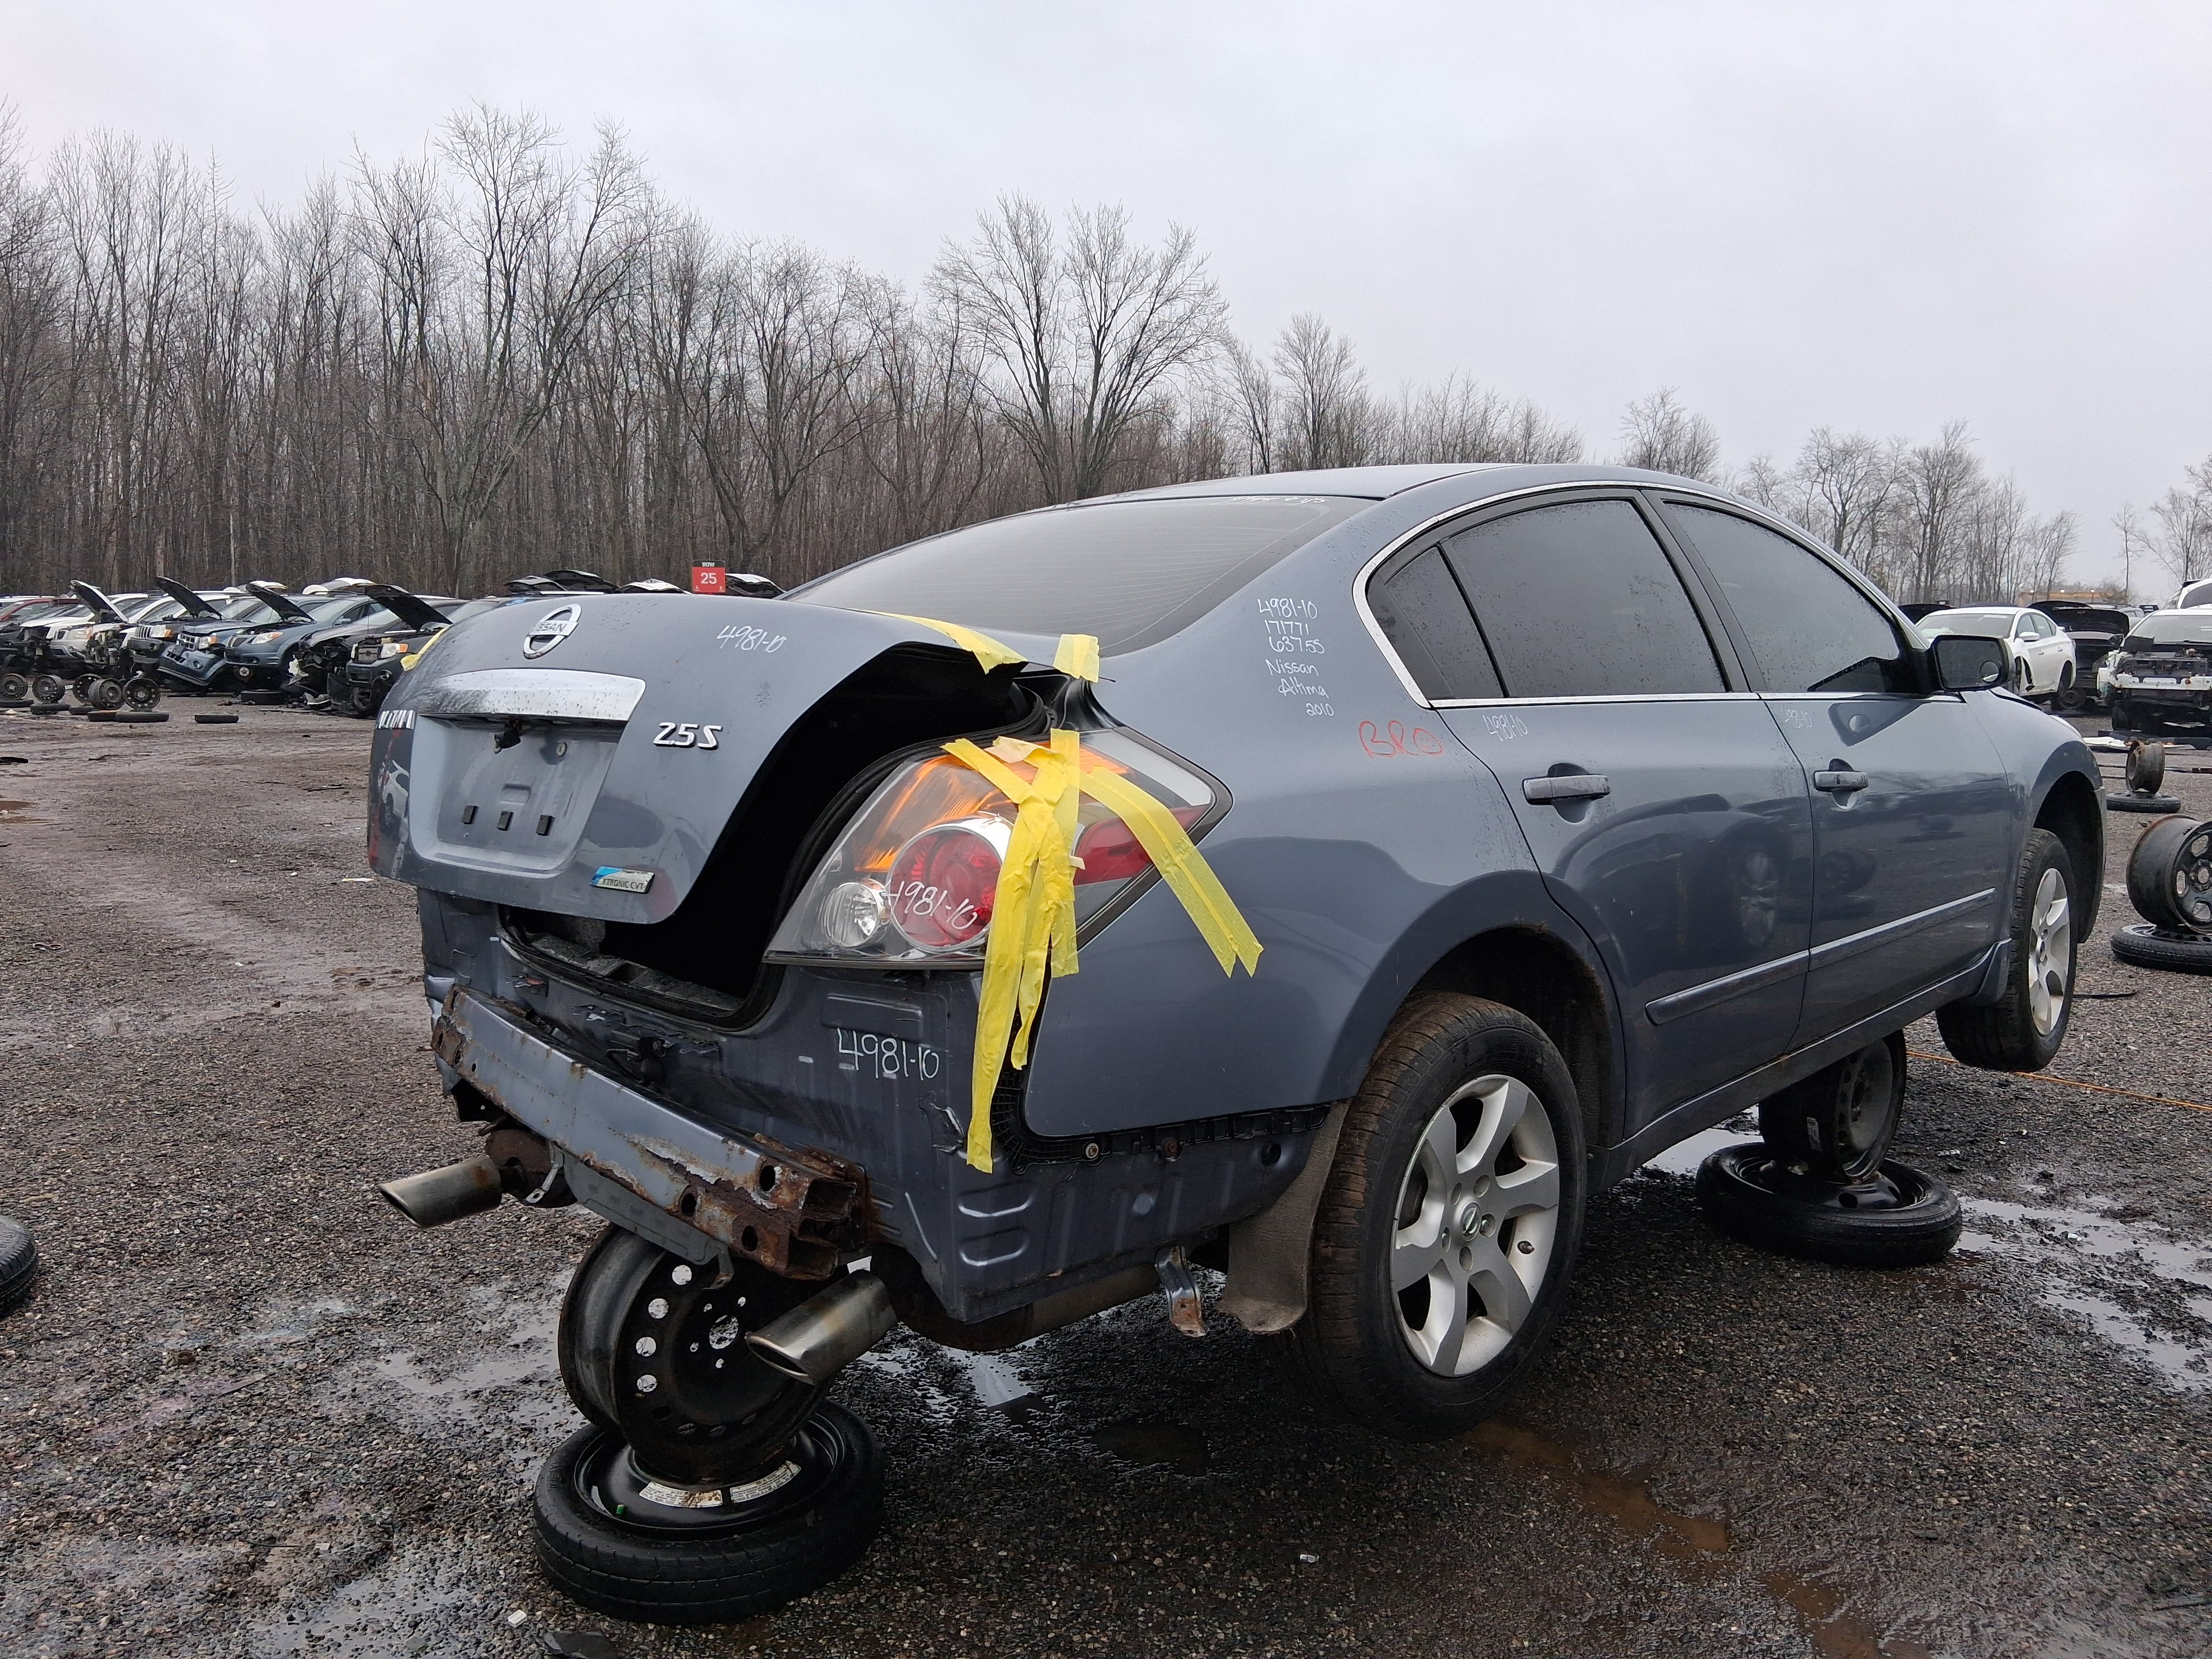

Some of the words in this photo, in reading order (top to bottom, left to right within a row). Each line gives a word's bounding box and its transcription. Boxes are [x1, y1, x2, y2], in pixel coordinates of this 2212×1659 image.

[700, 572, 717, 584] 25
[1257, 597, 1317, 619] 4981-10
[1264, 619, 1309, 635] 171771
[1269, 635, 1325, 654] 637.55
[1265, 659, 1319, 676] Nissan
[1278, 676, 1329, 699] Altima
[1306, 703, 1334, 716] 2010
[602, 878, 629, 889] XTRONIC
[630, 882, 644, 890] CVT
[881, 879, 978, 930] 4981-10
[837, 1027, 940, 1081] 4981-10
